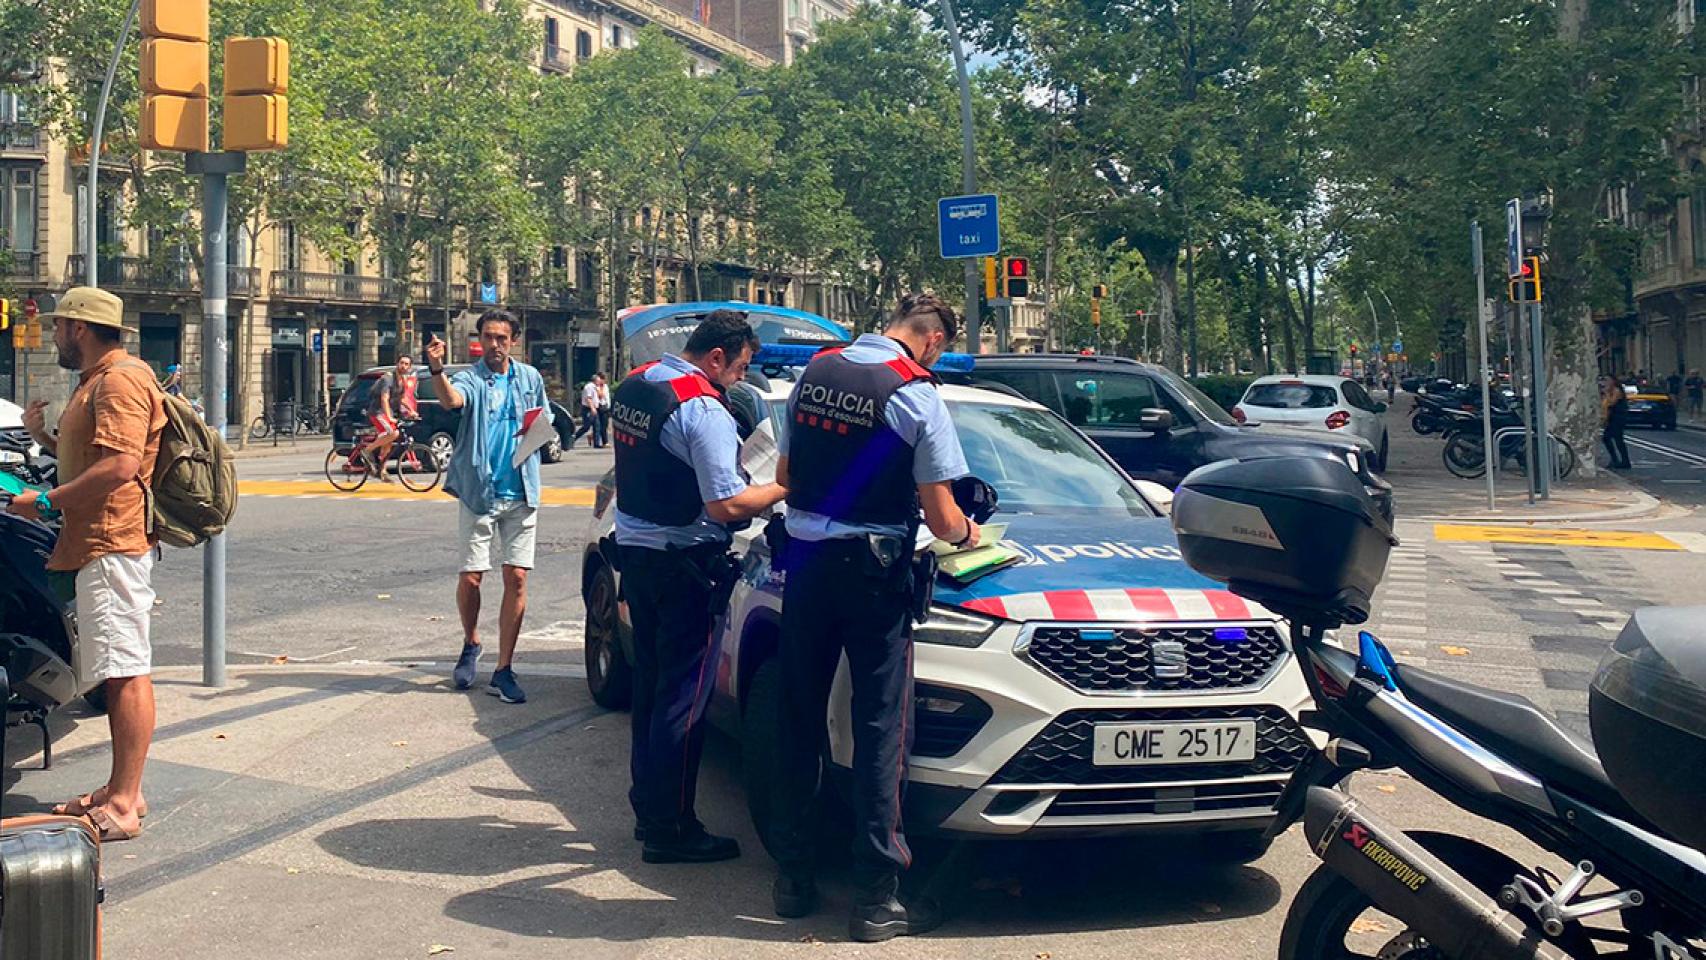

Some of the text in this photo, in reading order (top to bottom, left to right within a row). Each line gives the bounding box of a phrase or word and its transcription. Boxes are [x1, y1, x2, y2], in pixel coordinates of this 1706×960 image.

[959, 232, 981, 245] taxi
[800, 383, 875, 417] POLICIA
[613, 401, 651, 430] POLICIA
[1114, 727, 1241, 759] CME 2517
